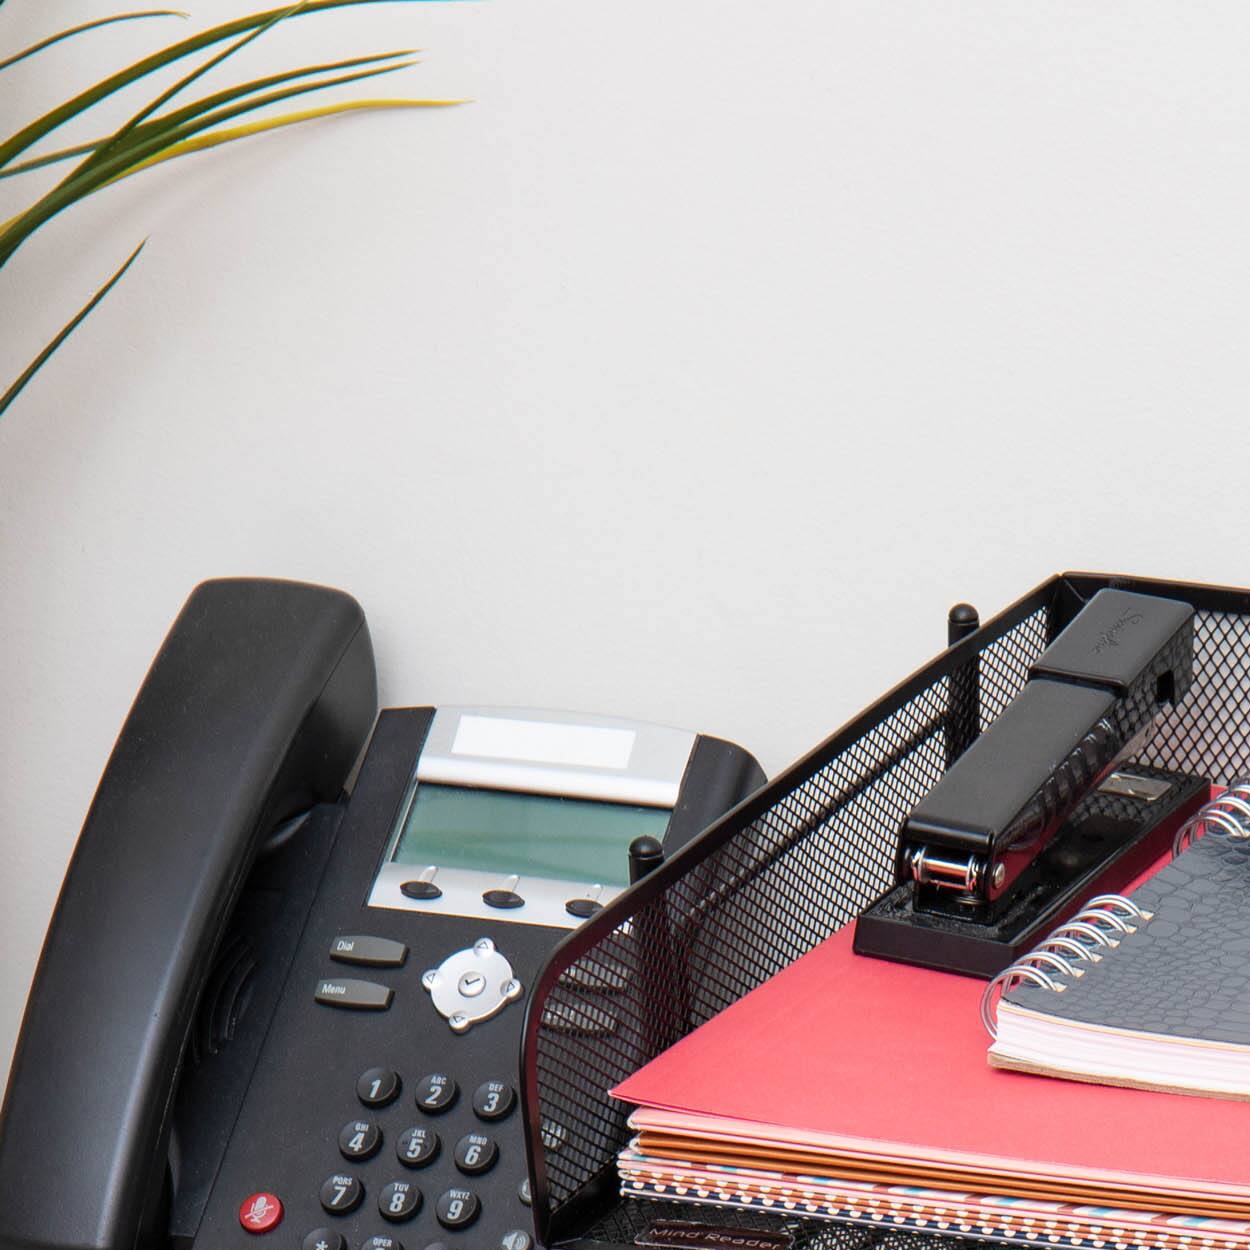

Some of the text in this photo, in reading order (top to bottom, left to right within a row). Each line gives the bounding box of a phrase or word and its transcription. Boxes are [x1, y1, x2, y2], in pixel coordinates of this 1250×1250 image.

[336, 940, 355, 952] Dial
[321, 983, 346, 995] Menu
[430, 1075, 447, 1086] ABC
[488, 1082, 504, 1092] DEF
[369, 1079, 382, 1099] 1
[424, 1085, 442, 1105] 2
[483, 1092, 500, 1113] 3
[354, 1122, 369, 1132] GHI
[411, 1129, 426, 1139] JKL
[348, 1132, 365, 1152] 4
[406, 1138, 424, 1158] 5
[468, 1135, 488, 1145] MNO
[464, 1145, 481, 1165] 6
[394, 1183, 409, 1192] TUV
[449, 1190, 471, 1200] WXYZ
[330, 1186, 347, 1206] 7
[389, 1193, 405, 1213] 8
[446, 1200, 464, 1220] 9
[373, 1237, 392, 1247] OPER
[648, 1227, 783, 1250] Mind Reader
